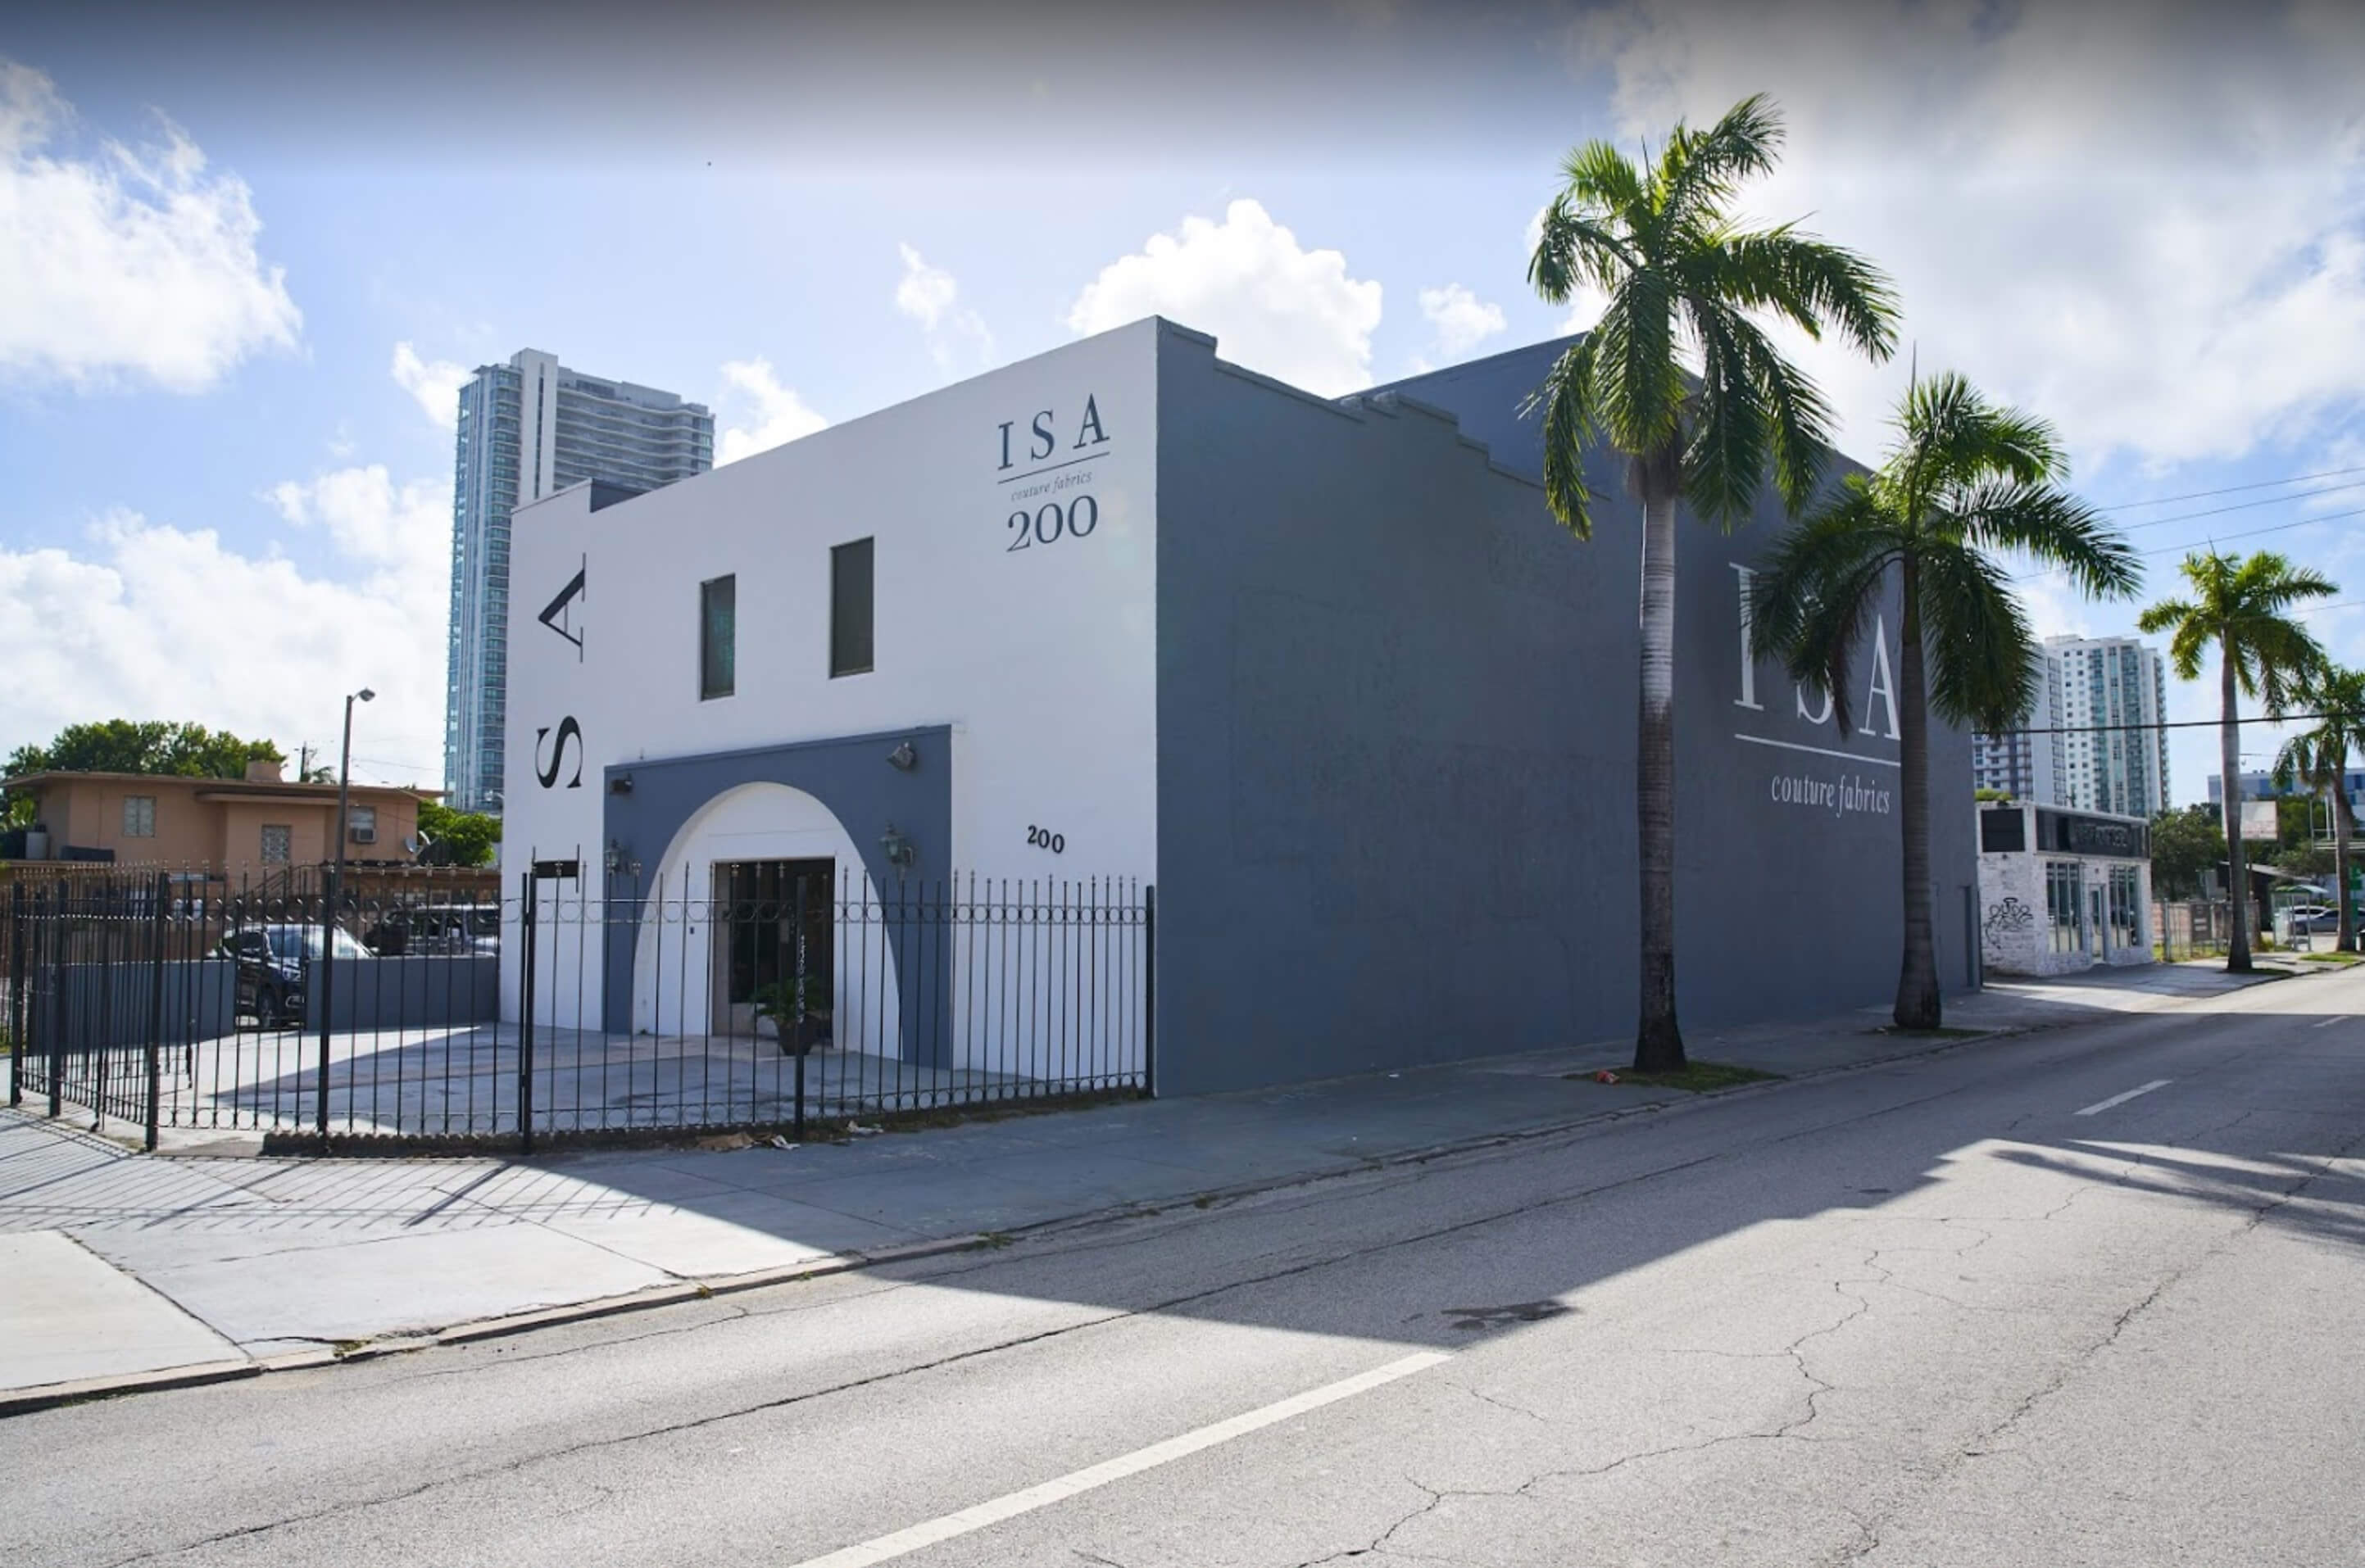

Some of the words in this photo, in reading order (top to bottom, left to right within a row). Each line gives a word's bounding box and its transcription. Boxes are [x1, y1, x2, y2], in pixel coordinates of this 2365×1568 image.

[997, 392, 1110, 470] ISA
[1052, 472, 1092, 493] fabrics
[1006, 495, 1098, 552] 200
[533, 552, 586, 894] ISA
[1772, 775, 1835, 808] couture
[1836, 774, 1891, 818] fabrics
[1027, 824, 1064, 854] 200
